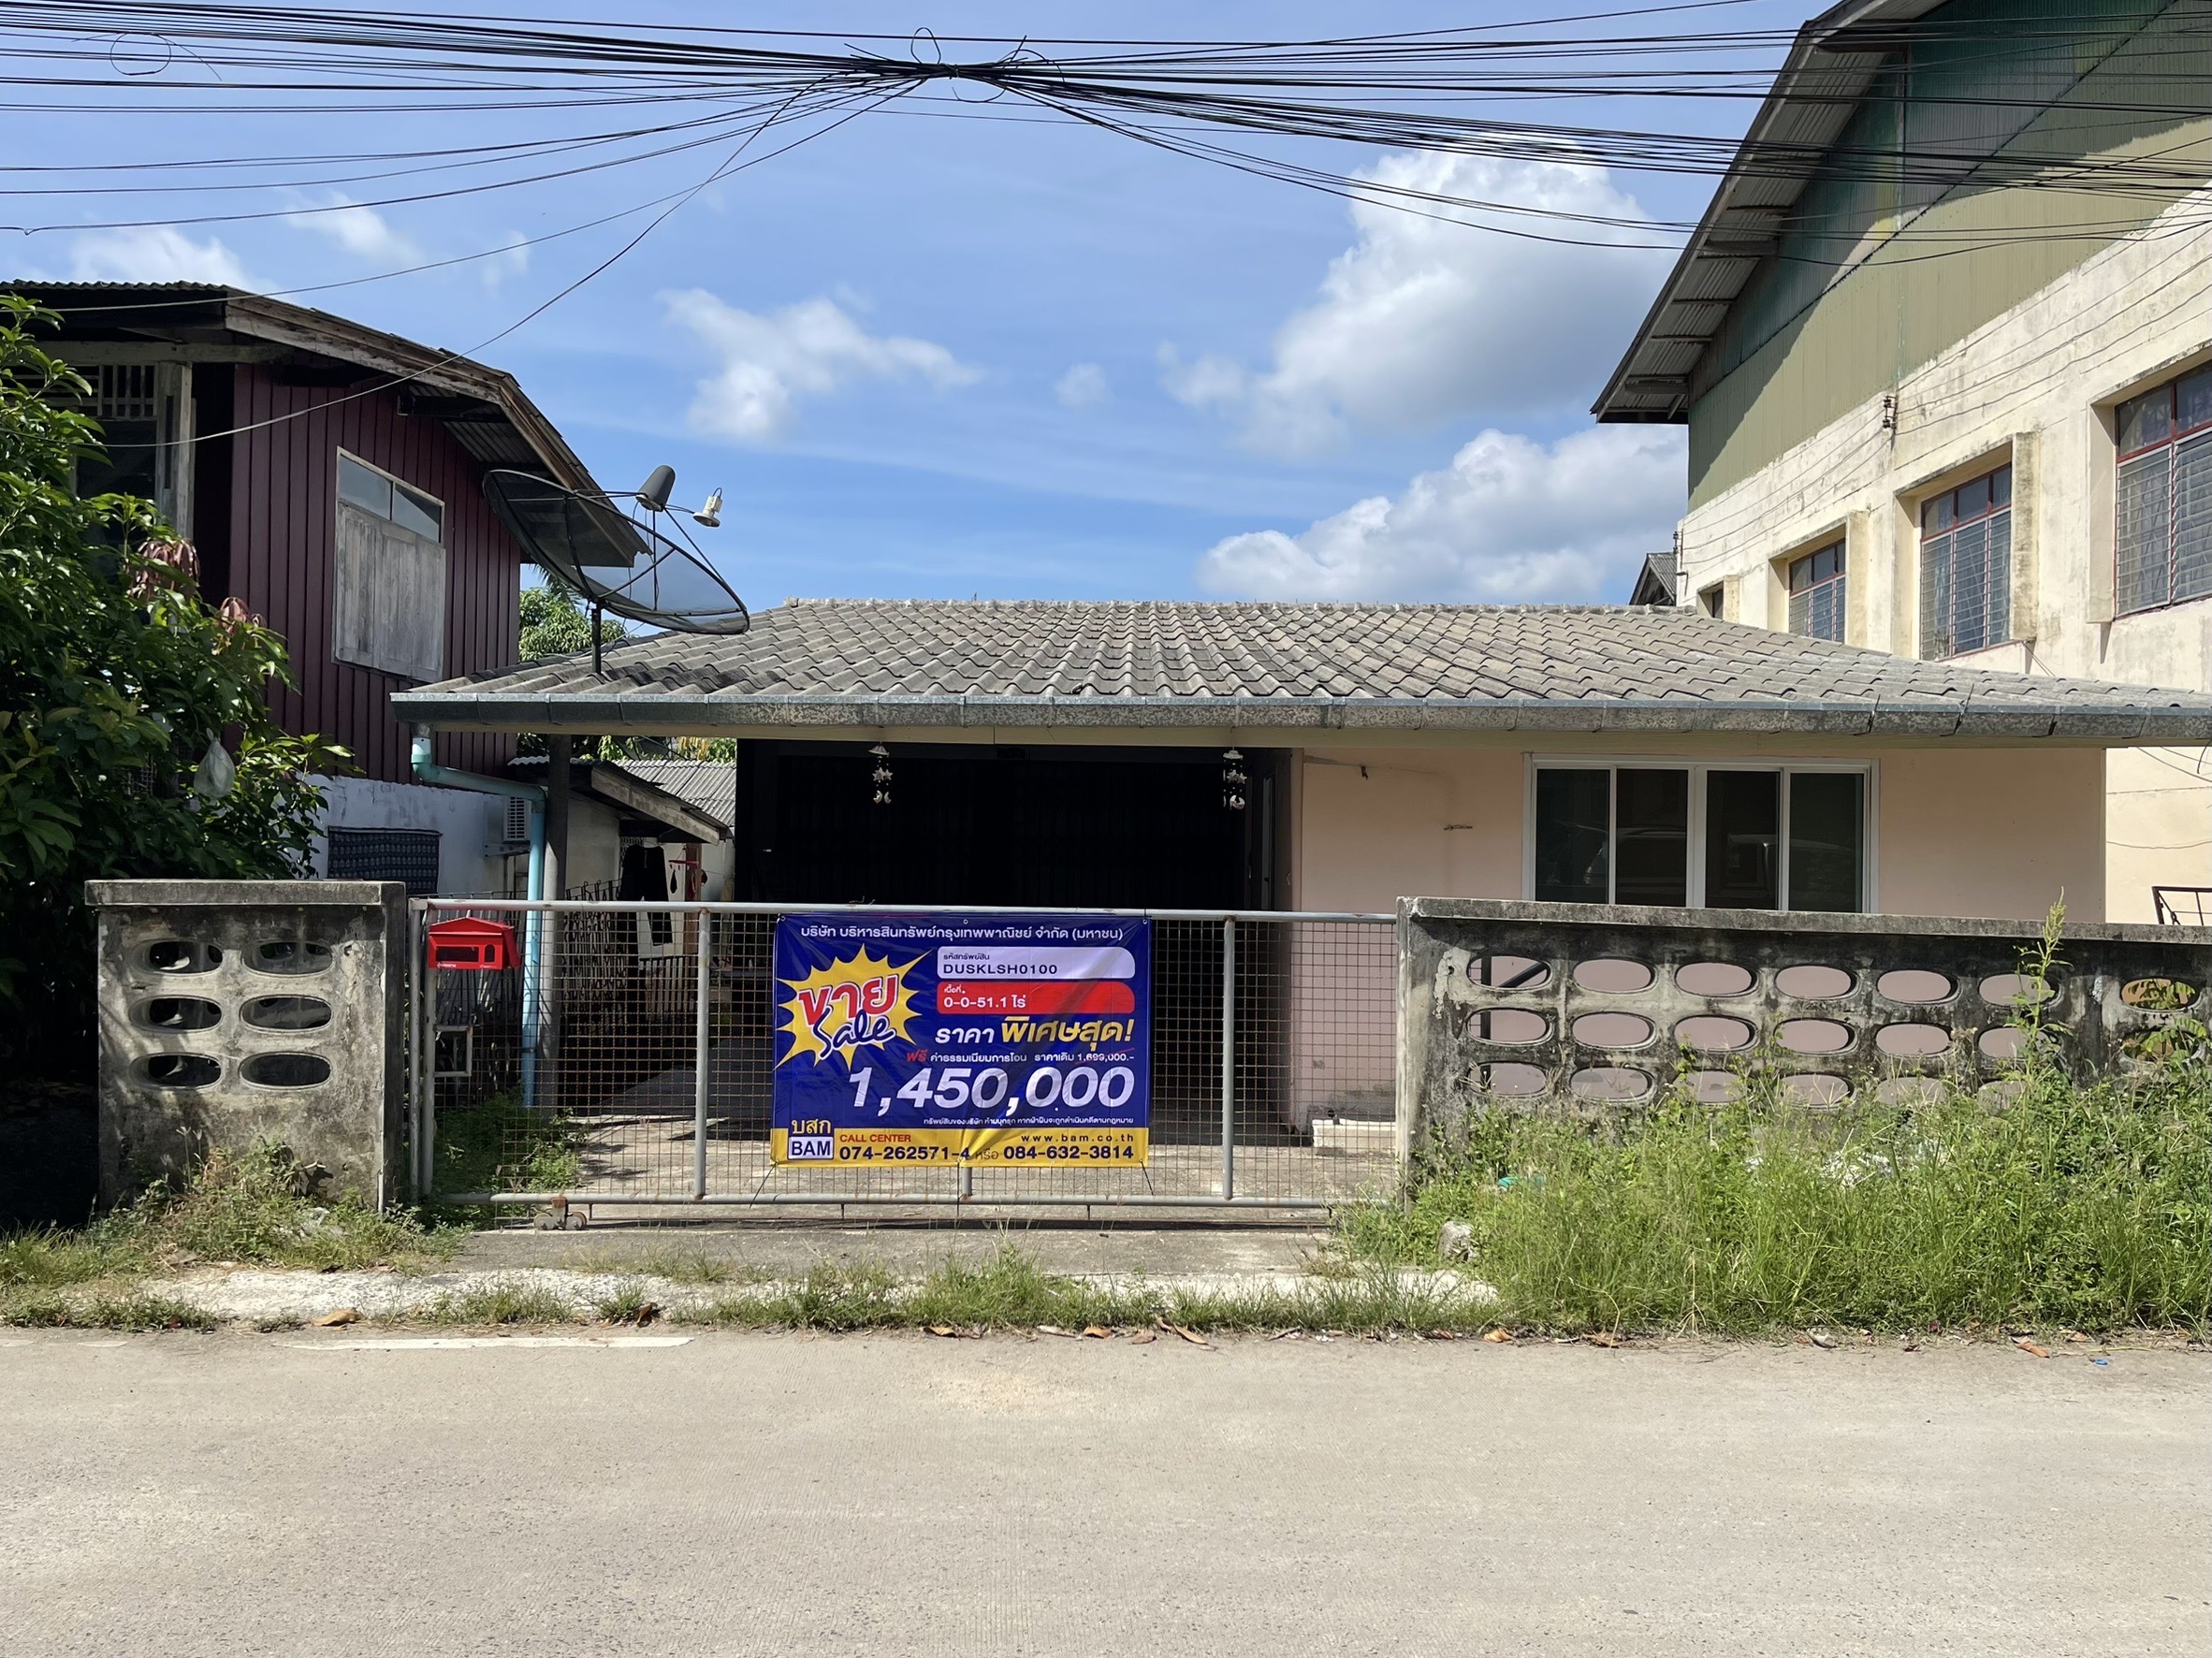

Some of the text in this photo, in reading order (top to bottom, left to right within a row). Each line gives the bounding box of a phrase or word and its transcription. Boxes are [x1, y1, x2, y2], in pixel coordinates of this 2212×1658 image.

[801, 924, 1123, 941] บริษัท บริหารสินทรัพย์กรุงเทพพาณิชย์ จำกัด (มหาชน)
[943, 964, 1057, 974] DUSKLSH0100
[797, 974, 898, 1026] ขาย
[943, 994, 1026, 1009] 0-0-51.1 ไร่
[811, 1006, 895, 1059] Sale
[935, 1015, 1135, 1052] ราคา พิเศษสุด!
[907, 1049, 928, 1062] ฟรี
[849, 1067, 1135, 1116] 1,450,000
[791, 1118, 831, 1134] บสก
[839, 1134, 911, 1142] CALL CENTER
[1021, 1133, 1134, 1142] www.bam.co.th
[792, 1140, 831, 1156] BAM
[839, 1145, 1134, 1160] 074-262571-4 หรือ 084-632-3814
